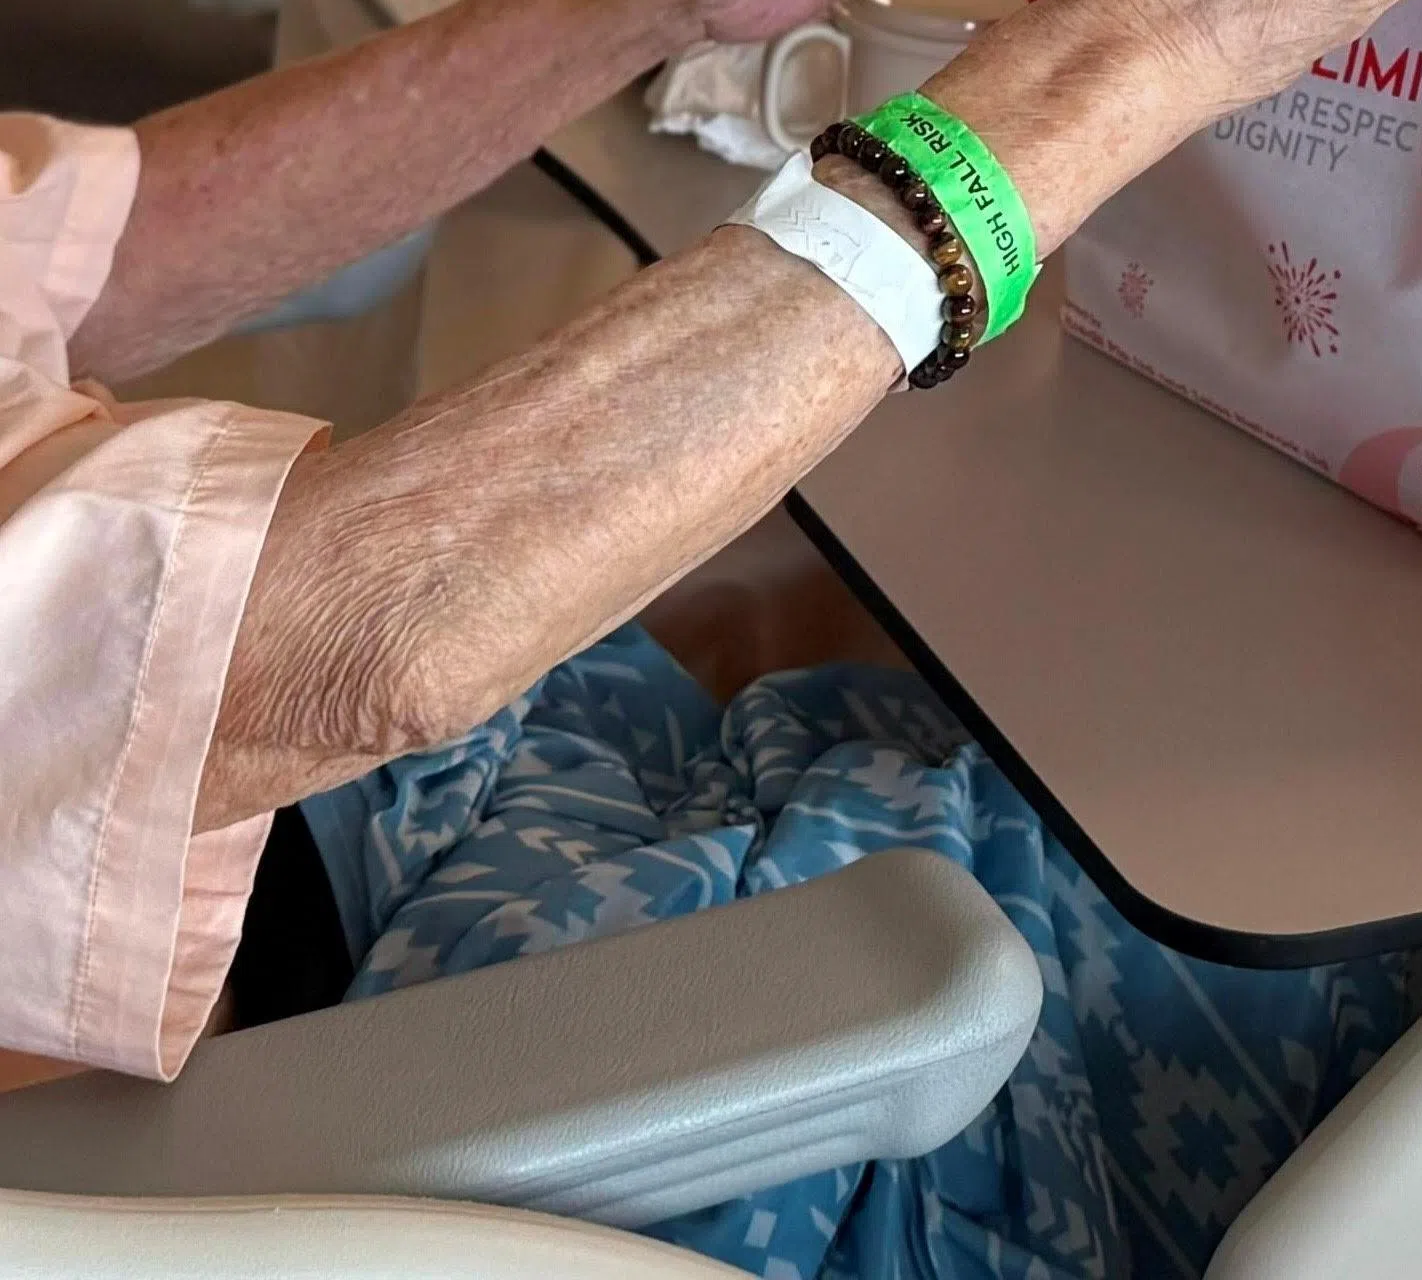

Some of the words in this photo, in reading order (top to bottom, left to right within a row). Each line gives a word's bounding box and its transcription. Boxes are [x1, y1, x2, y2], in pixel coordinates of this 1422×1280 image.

[901, 111, 953, 155] RISK
[1213, 114, 1350, 172] DIGNITY
[947, 152, 995, 211] FALL
[985, 211, 1020, 277] HIGH
